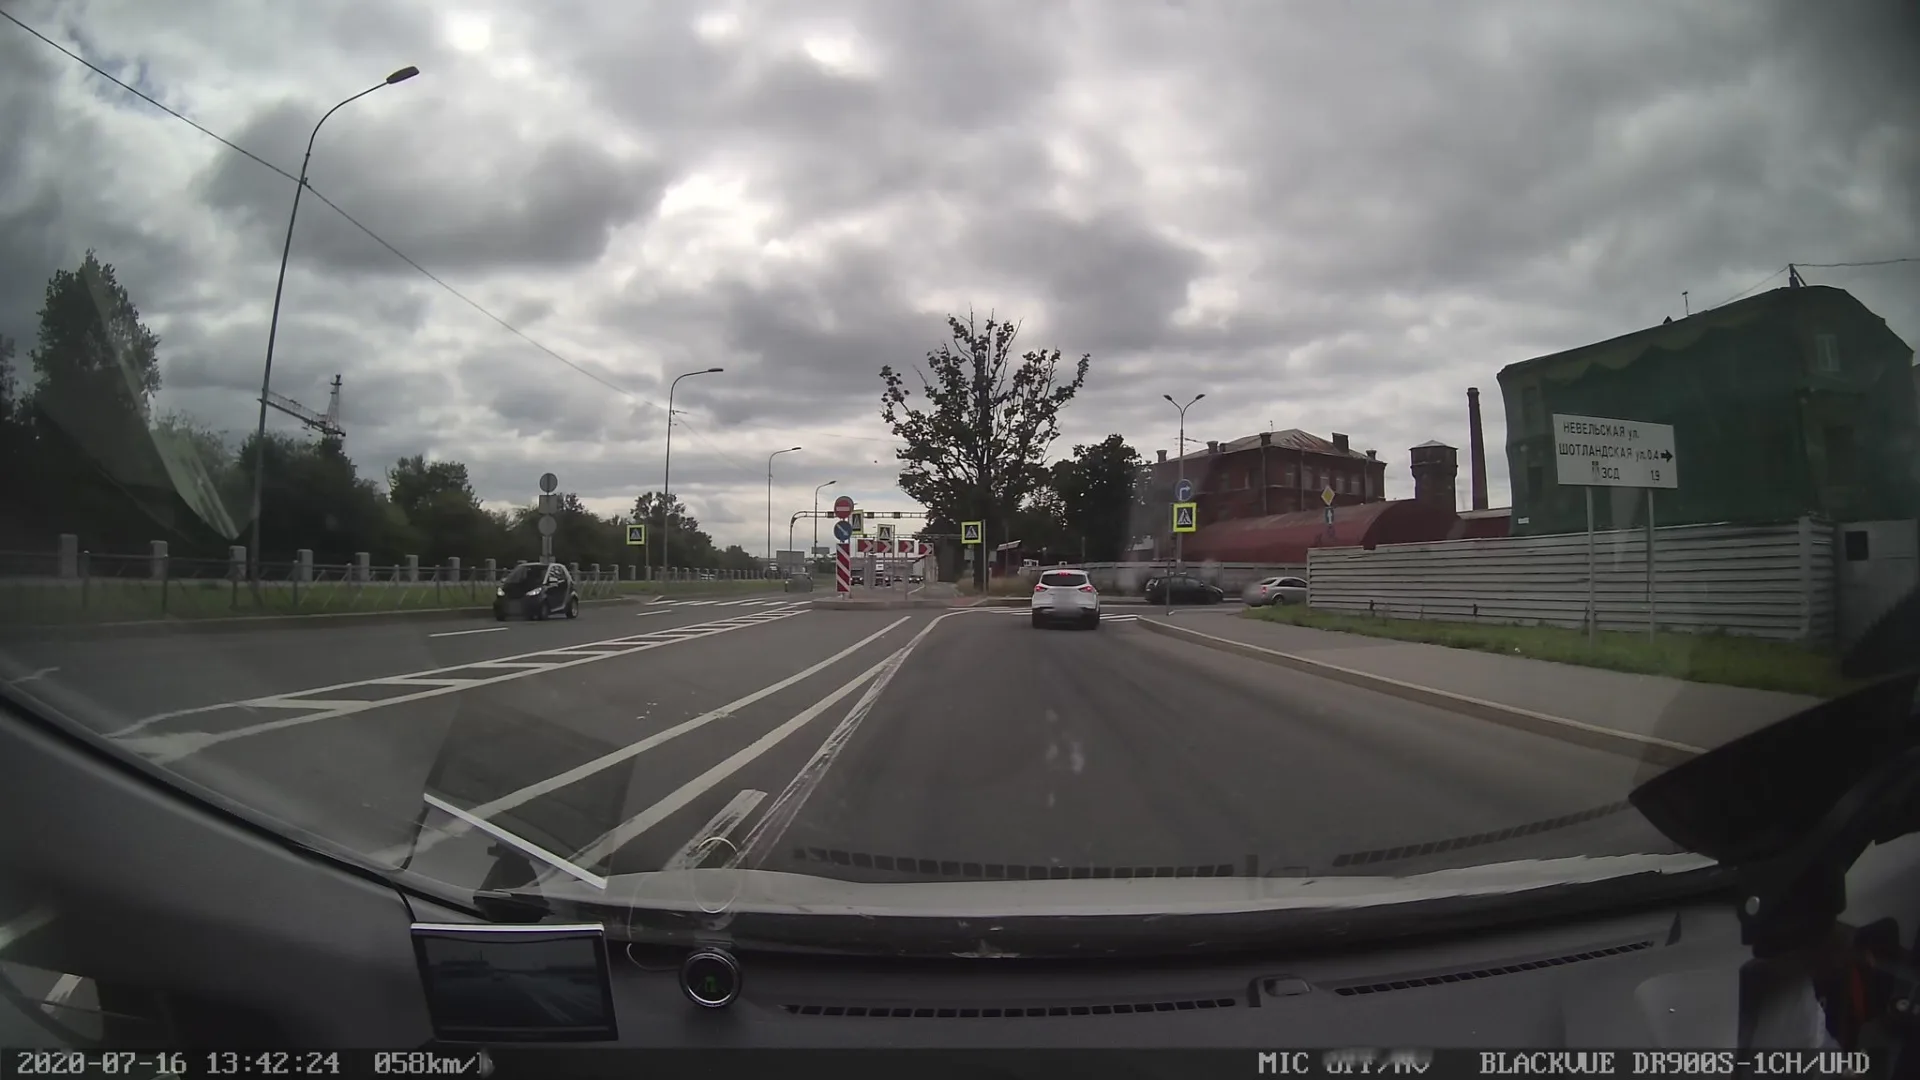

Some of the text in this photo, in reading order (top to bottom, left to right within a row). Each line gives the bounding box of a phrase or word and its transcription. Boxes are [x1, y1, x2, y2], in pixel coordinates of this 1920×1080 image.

[1563, 421, 1625, 437] НЕВЕЛЬСКАЯ
[1558, 443, 1633, 459] ШОТЛАНДСКАЯ
[1602, 467, 1620, 480] ЗСД
